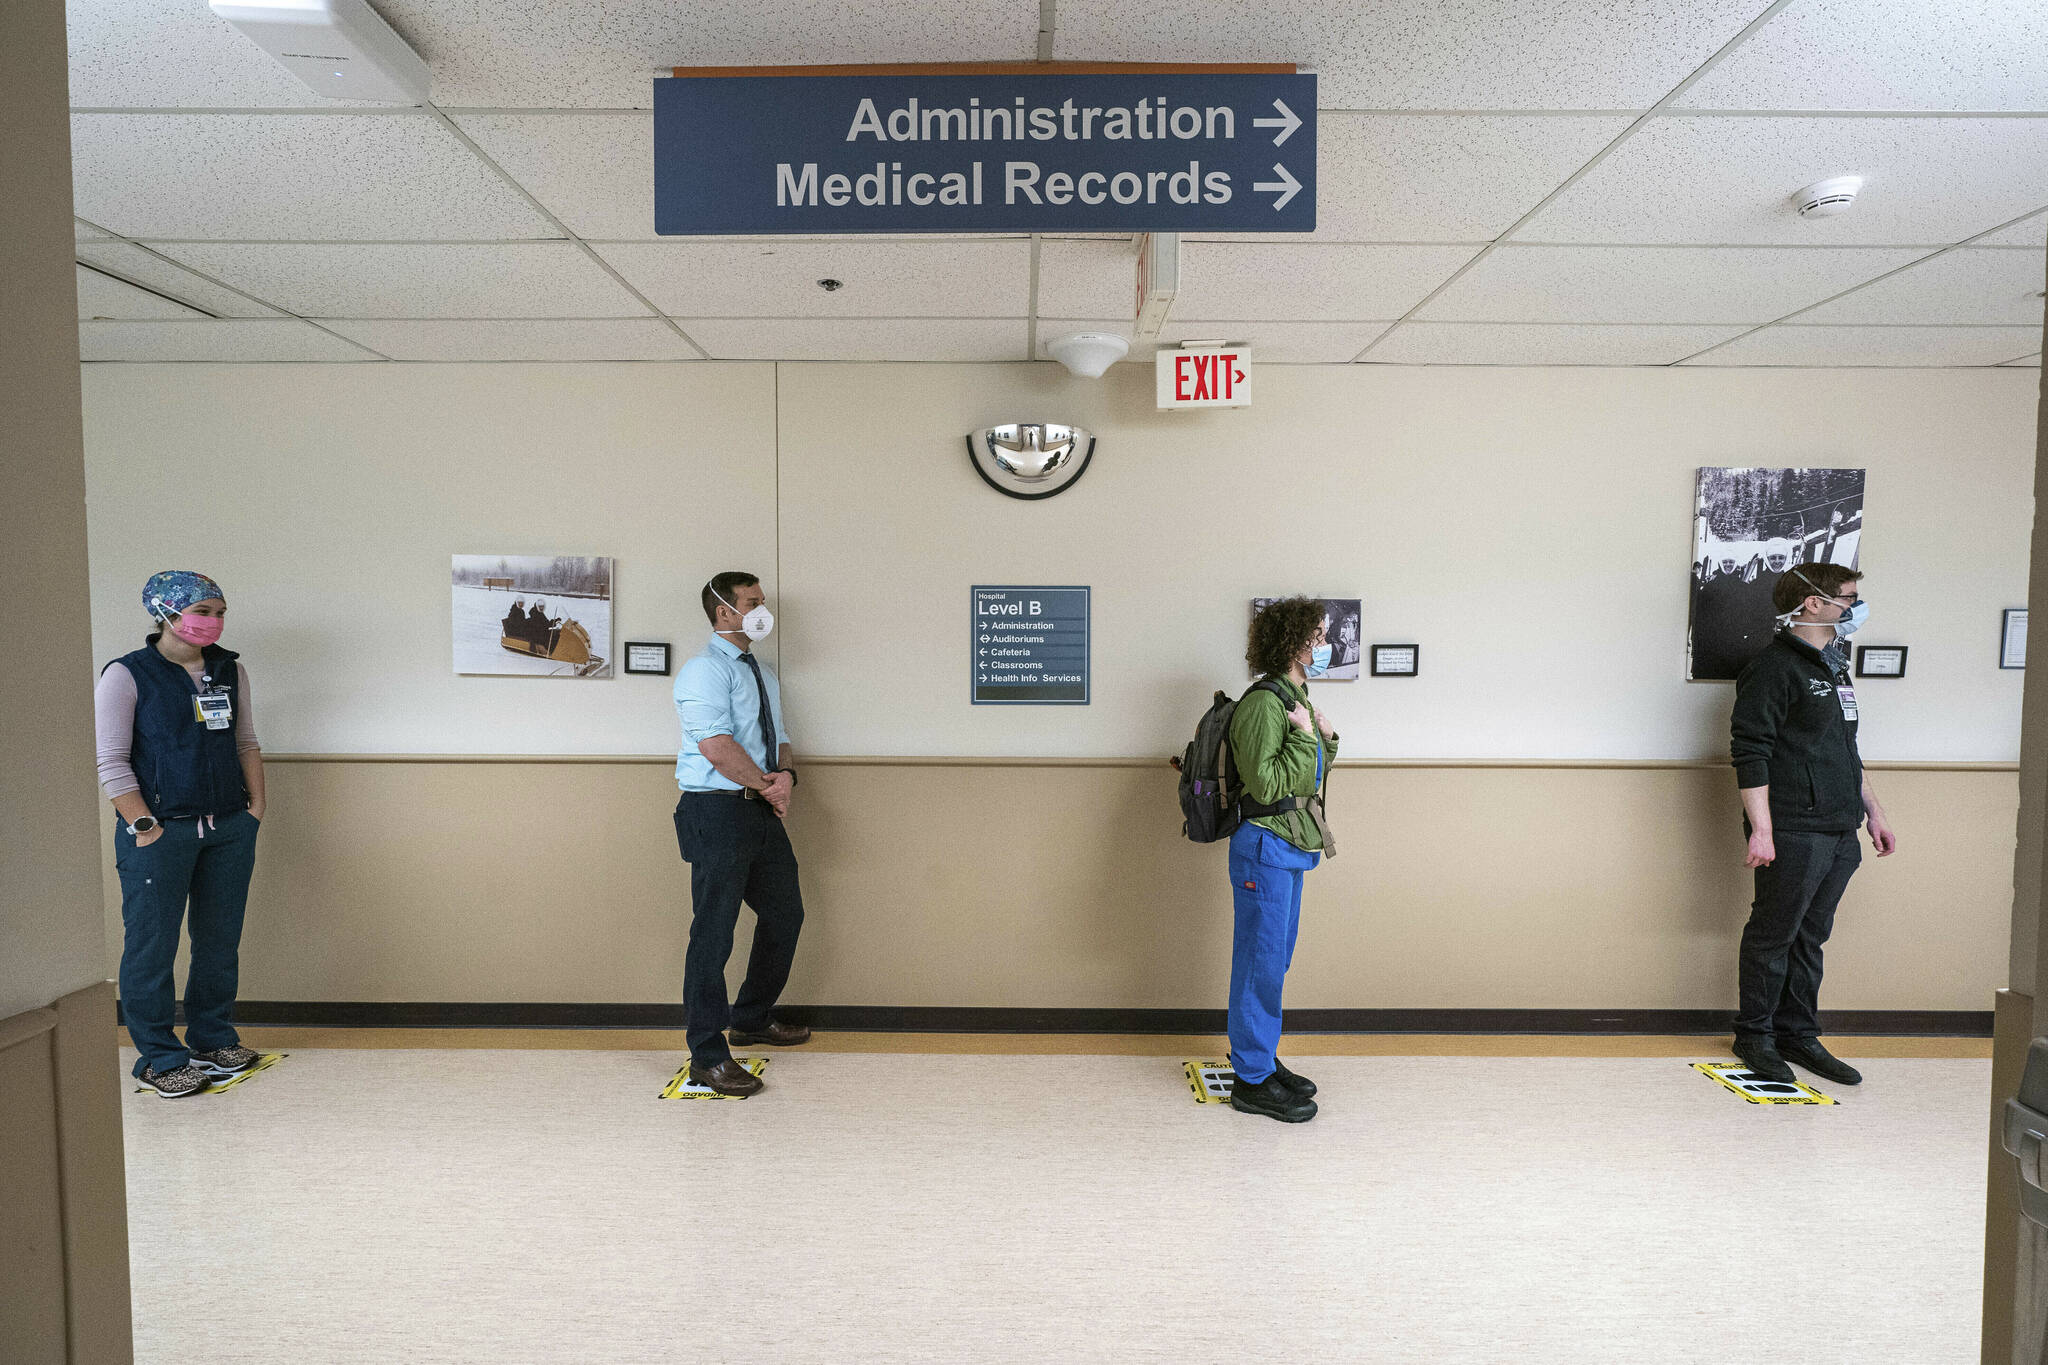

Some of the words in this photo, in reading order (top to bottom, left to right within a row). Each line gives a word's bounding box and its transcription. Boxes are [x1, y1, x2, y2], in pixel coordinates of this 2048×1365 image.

[847, 97, 1235, 142] Administration
[776, 162, 983, 207] Medical
[1005, 161, 1233, 205] Records
[1175, 354, 1237, 401] EXIT
[978, 593, 1006, 601] Hospital
[978, 601, 1023, 616] Level
[1029, 601, 1042, 616] B
[991, 621, 1054, 630] Administration
[991, 634, 1045, 643] Auditoriums
[990, 647, 1031, 656] Cafeteria
[991, 660, 1043, 670] Classrooms
[991, 674, 1019, 683] Health
[1021, 674, 1038, 682] Info
[1042, 674, 1082, 682] Services
